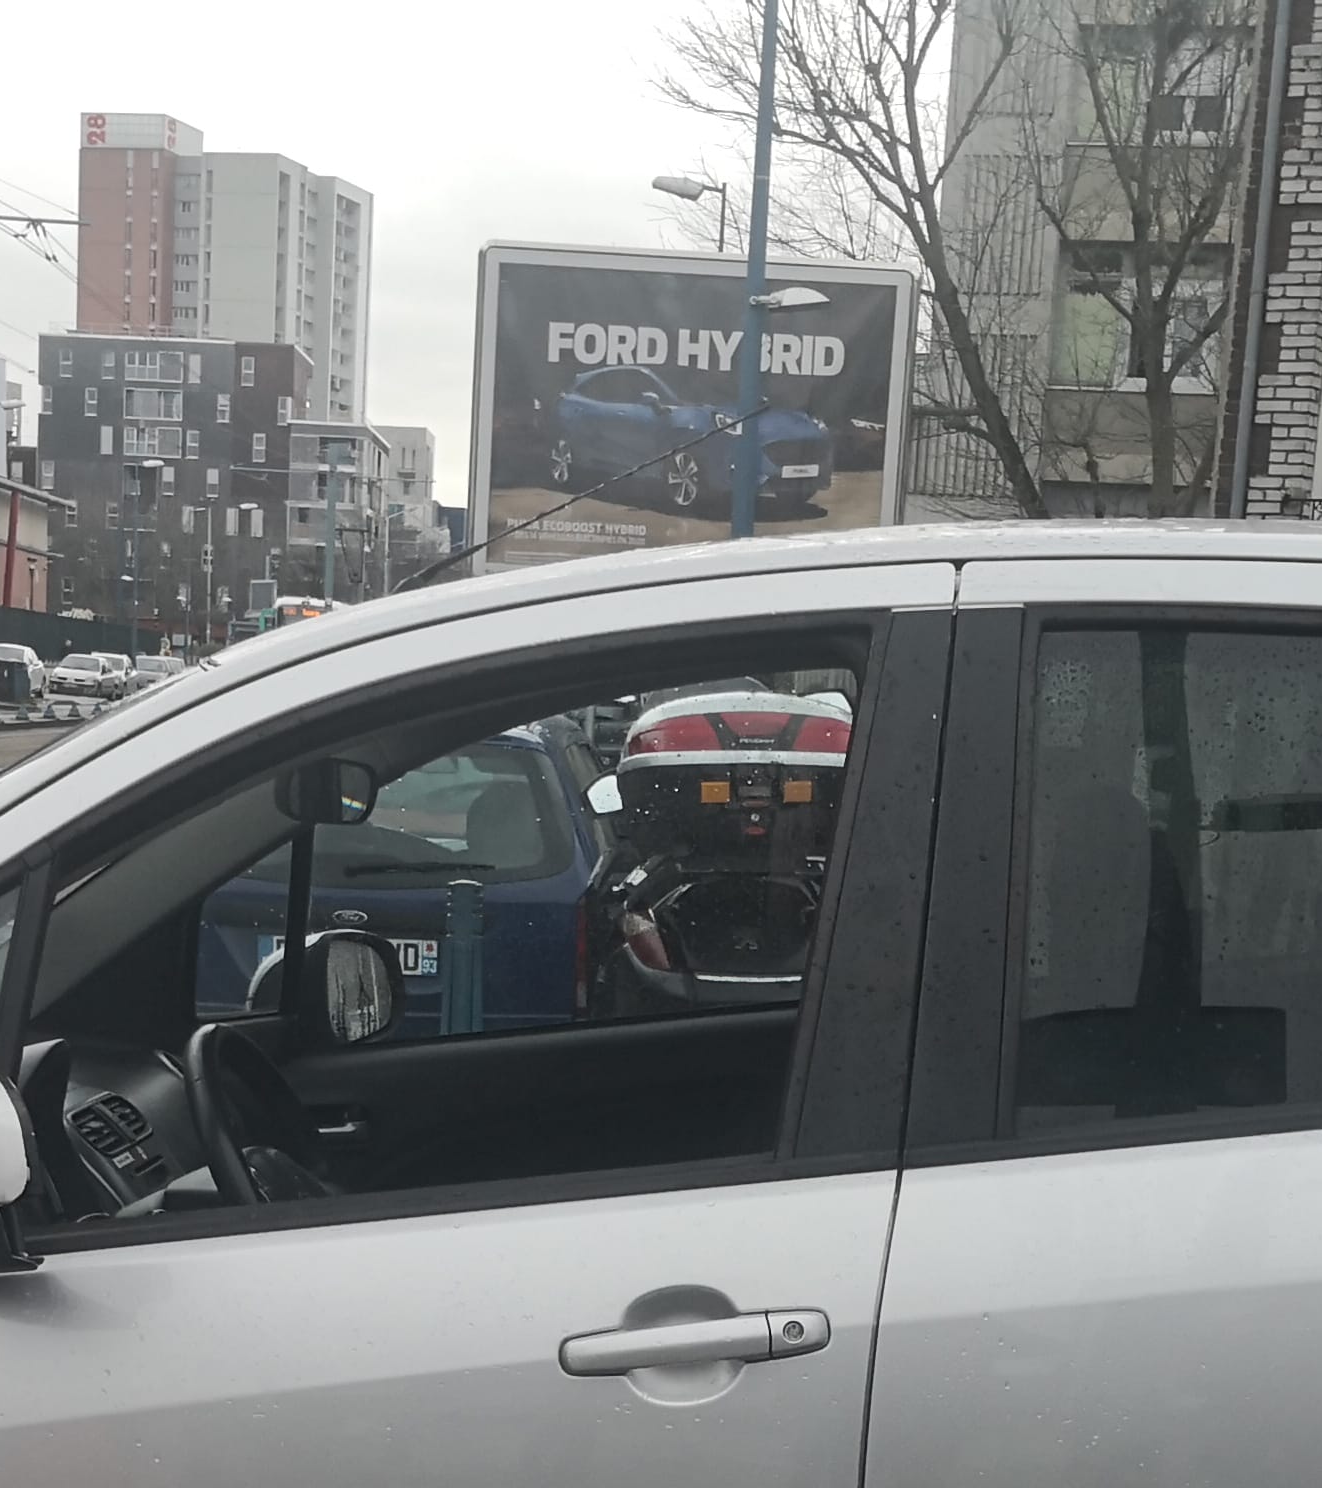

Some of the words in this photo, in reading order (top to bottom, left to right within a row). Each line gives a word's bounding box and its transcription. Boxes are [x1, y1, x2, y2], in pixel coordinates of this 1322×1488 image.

[87, 114, 106, 145] 28
[548, 321, 668, 365] FORD
[422, 959, 438, 974] 93
